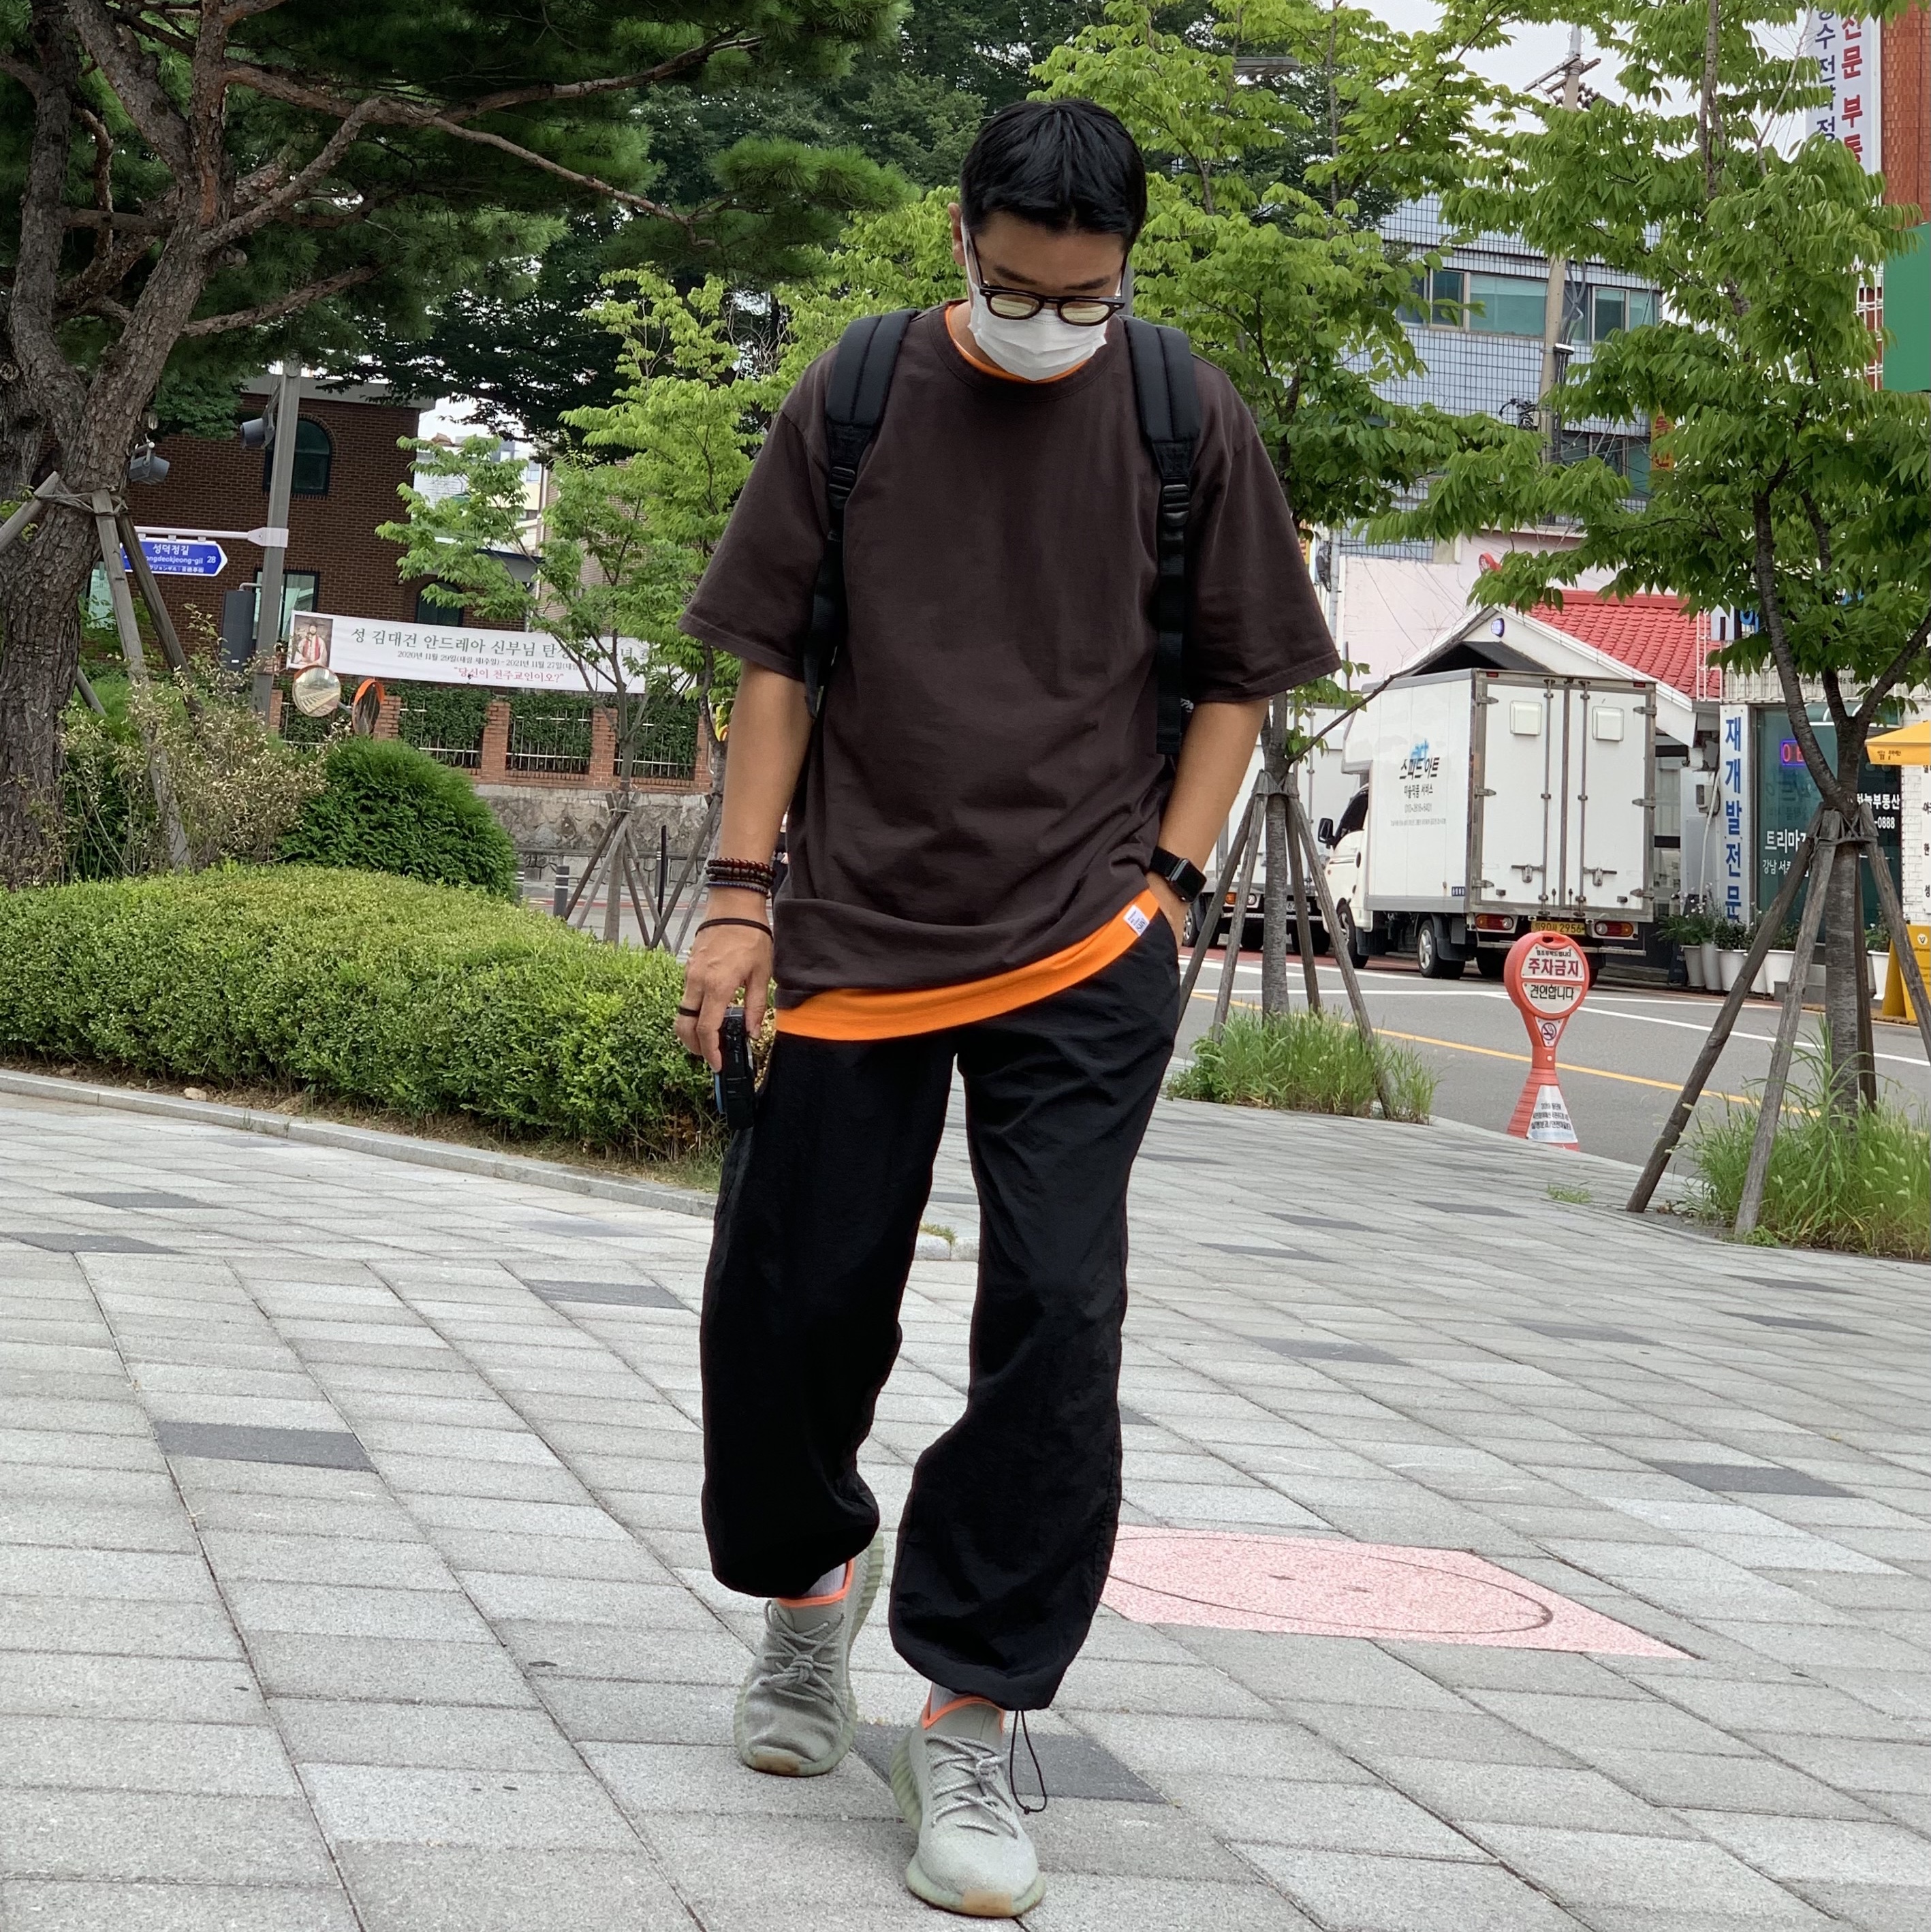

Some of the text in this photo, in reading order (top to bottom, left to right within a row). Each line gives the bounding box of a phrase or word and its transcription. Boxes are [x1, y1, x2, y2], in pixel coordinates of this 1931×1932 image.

[153, 544, 189, 556] 성덕정길
[206, 555, 217, 564] 28
[351, 627, 365, 643] 성
[372, 629, 418, 648] 김대건
[424, 634, 486, 653] 안드레아
[492, 640, 535, 657] 신부님
[397, 650, 423, 660] 2020년
[425, 653, 438, 661] 11월
[532, 660, 545, 669] 11월
[1725, 717, 1742, 920] 재개발전문
[1762, 859, 1777, 875] 강남
[1559, 923, 1582, 933] 2956
[1528, 958, 1579, 978] 주차금지
[1530, 984, 1574, 1001] 견인합니다
